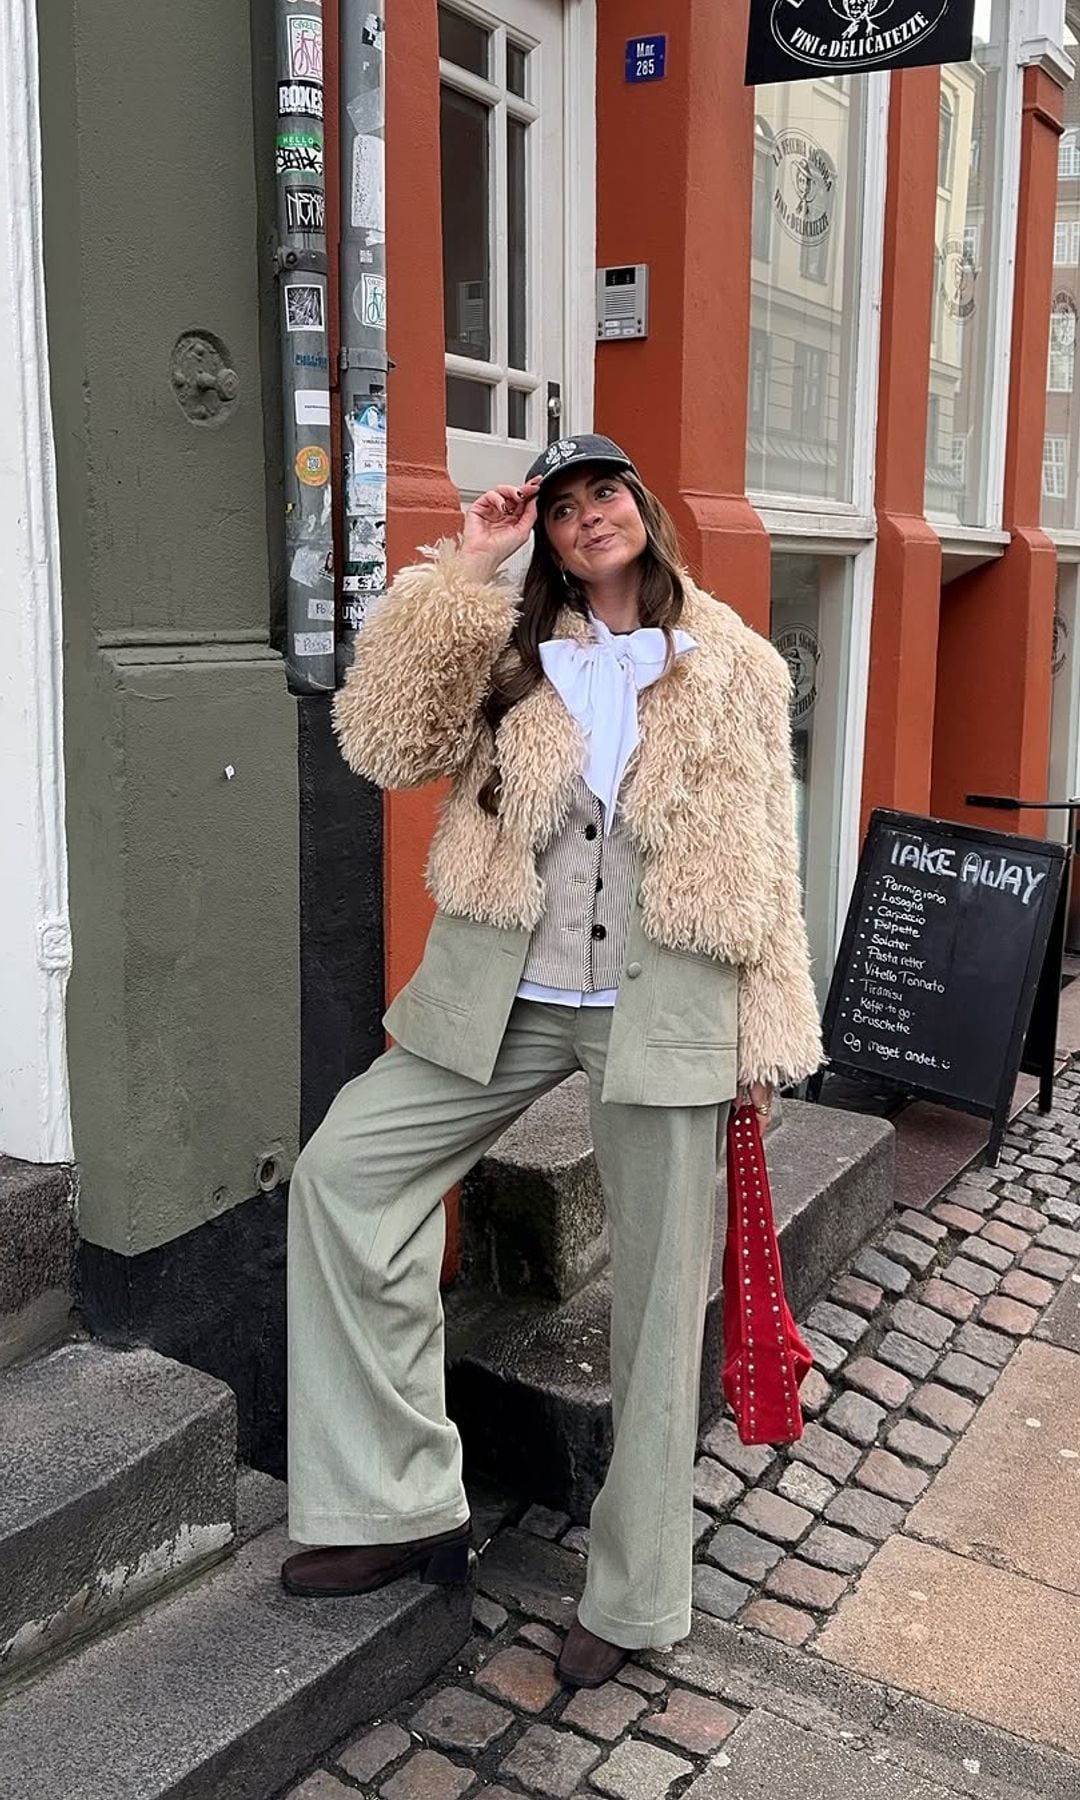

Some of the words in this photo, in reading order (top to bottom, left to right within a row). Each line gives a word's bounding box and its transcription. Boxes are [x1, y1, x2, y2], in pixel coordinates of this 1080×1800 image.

[790, 27, 820, 54] VINI
[818, 44, 828, 57] e
[828, 11, 929, 57] DELICATEZZE
[636, 59, 655, 76] 285
[283, 135, 314, 145] HELLO
[888, 831, 957, 878] TAKE
[960, 851, 1046, 905] AWAY
[881, 892, 924, 912] Lasagna
[877, 905, 926, 925] Carpaccio
[874, 918, 921, 938] Polpette
[871, 932, 911, 950] Salater
[867, 946, 898, 965] Pasta
[900, 957, 926, 970] retter
[865, 961, 897, 982] Vitello
[898, 971, 945, 993] Tonnato
[860, 978, 902, 1001] Tiramisu
[843, 1032, 861, 1053] Og
[868, 1041, 900, 1061] meget
